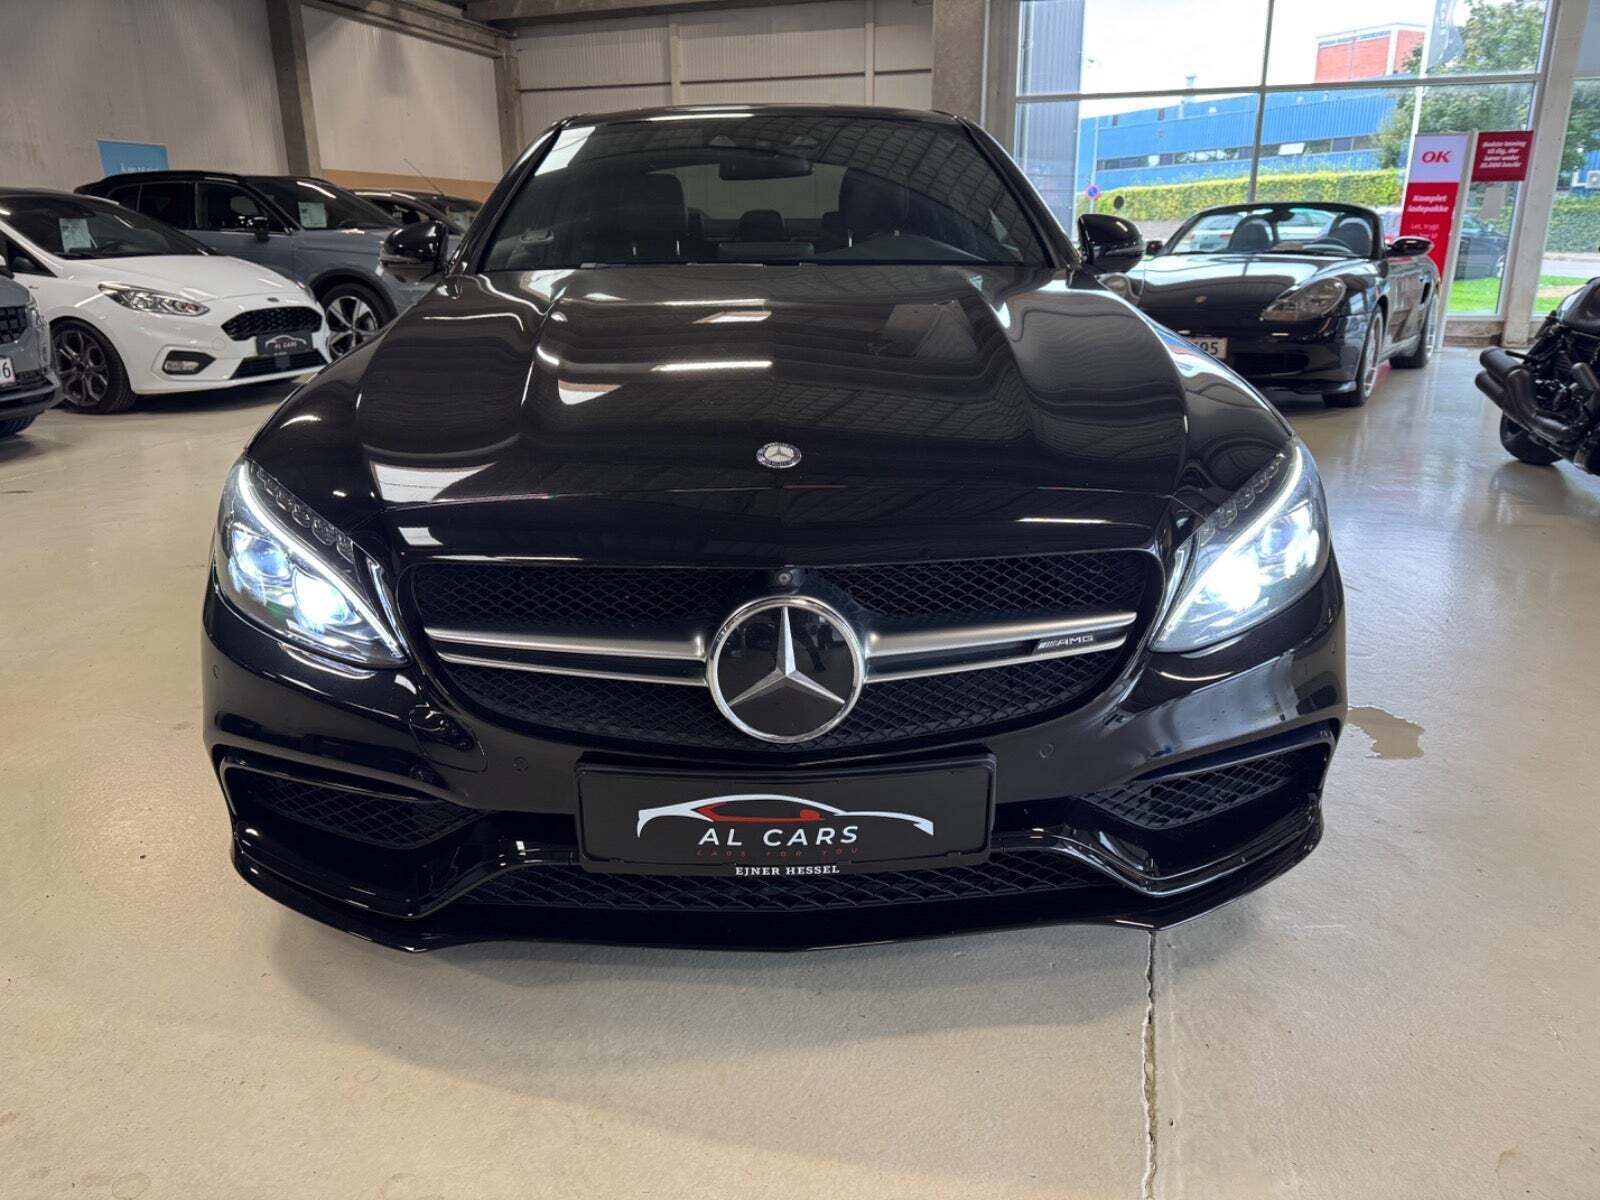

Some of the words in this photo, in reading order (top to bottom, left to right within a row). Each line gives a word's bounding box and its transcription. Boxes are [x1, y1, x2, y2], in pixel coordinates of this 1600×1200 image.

[1421, 150, 1452, 163] OK
[1412, 194, 1448, 204] Komplet
[2, 361, 11, 379] 6
[698, 827, 743, 847] AL
[762, 825, 859, 847] CARS
[735, 865, 780, 877] EJNER
[785, 864, 840, 876] HESSEL
